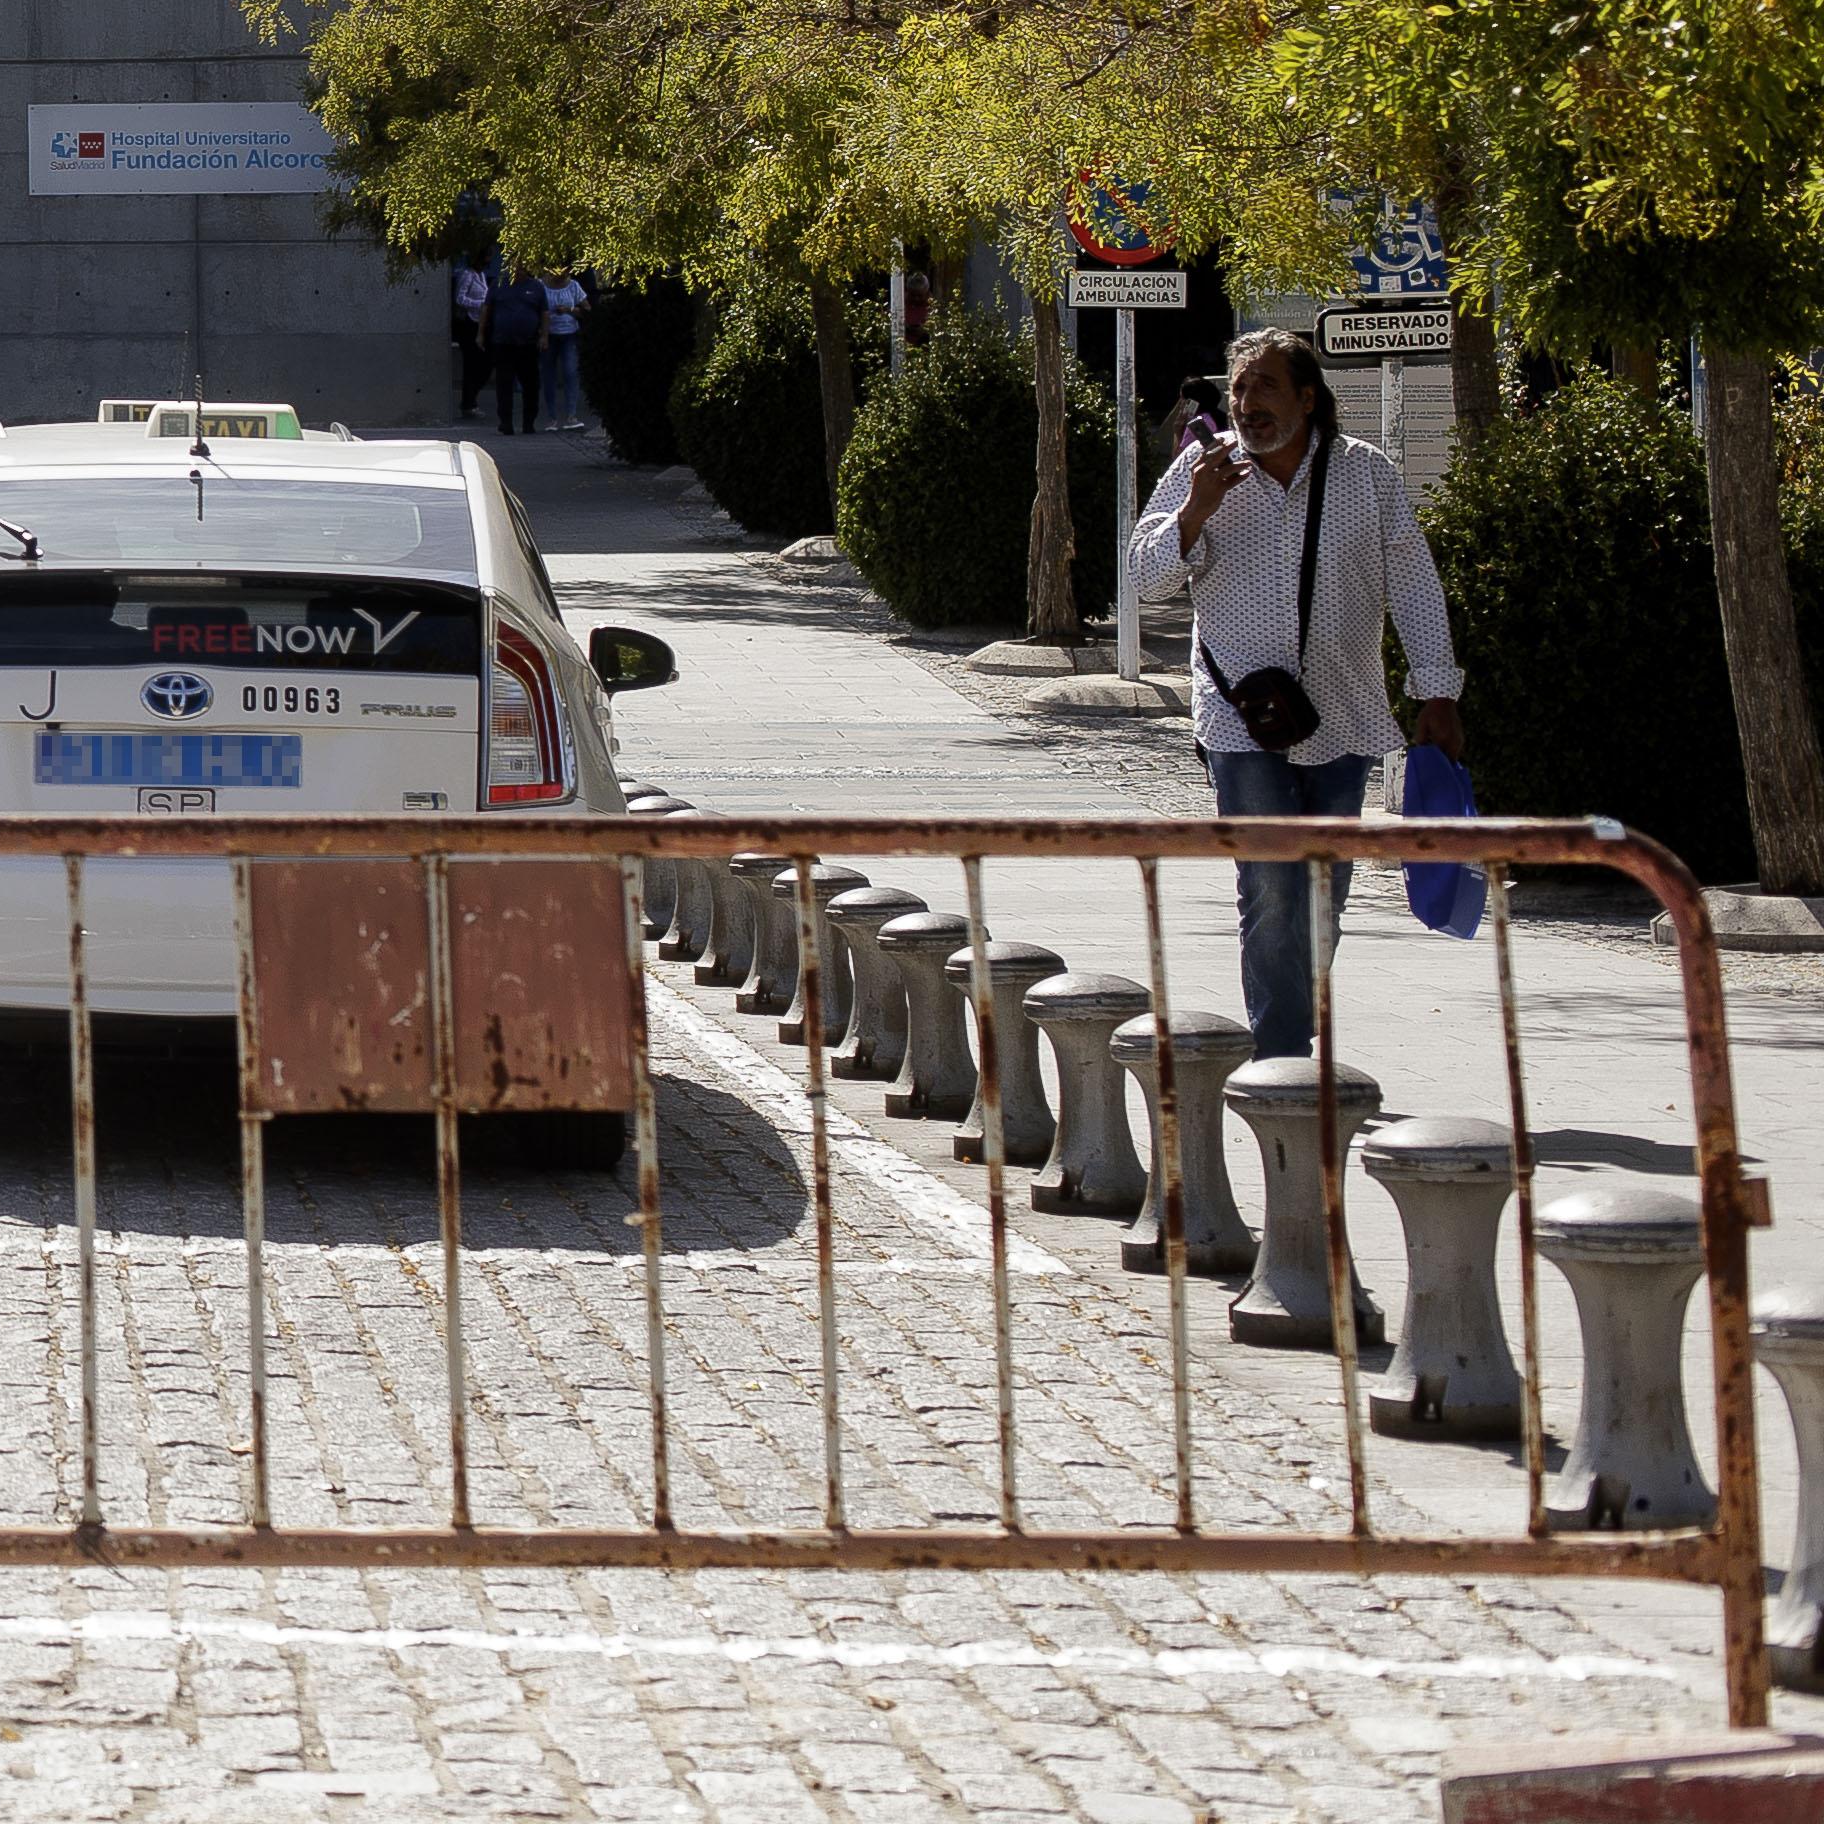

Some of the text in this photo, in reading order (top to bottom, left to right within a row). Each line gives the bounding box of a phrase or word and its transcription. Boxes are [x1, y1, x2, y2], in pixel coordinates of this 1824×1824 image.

[111, 130, 291, 149] Hospital Universitario
[111, 148, 239, 170] Fundación
[1078, 274, 1178, 289] CIRCULACIÓN
[1074, 290, 1181, 303] AMBULANCIAS
[1340, 313, 1449, 332] RESERVADO
[201, 420, 266, 438] TAXI
[242, 684, 342, 715] 00963
